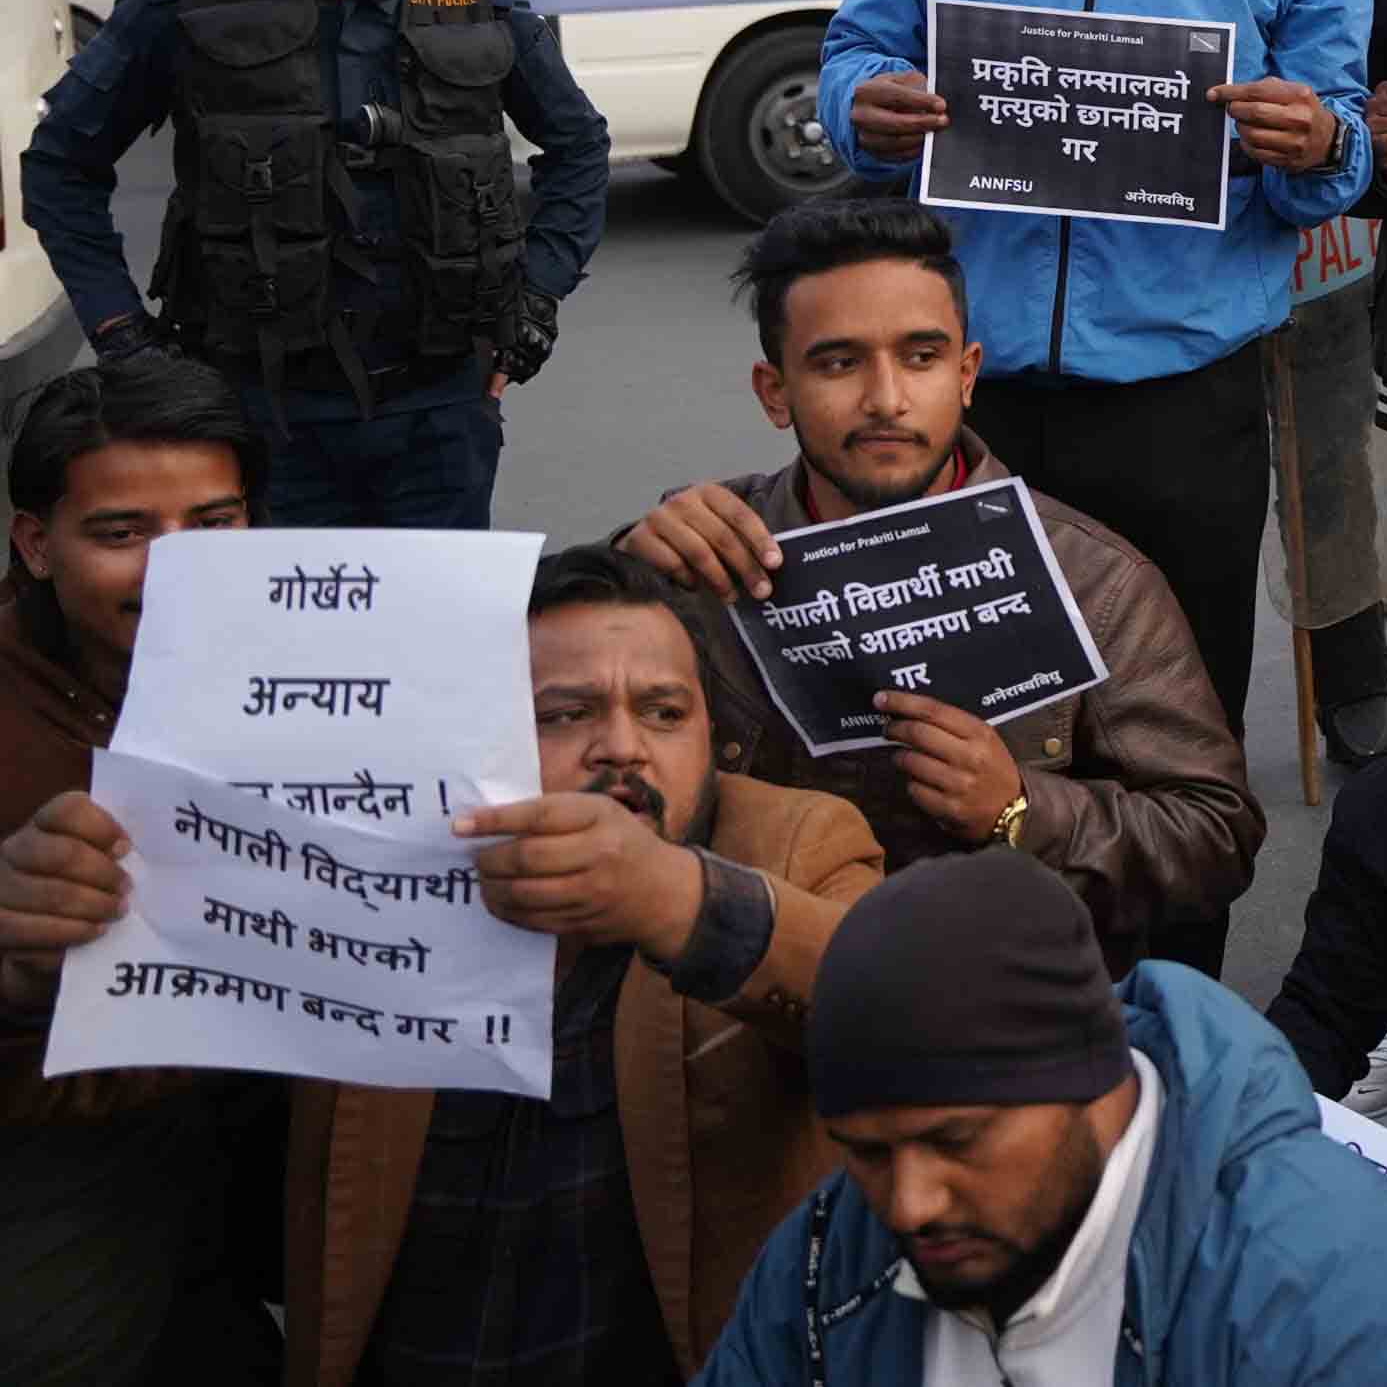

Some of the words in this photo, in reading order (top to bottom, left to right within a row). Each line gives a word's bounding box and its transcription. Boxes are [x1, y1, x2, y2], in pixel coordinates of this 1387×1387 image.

[1020, 25, 1055, 38] Justice
[1057, 28, 1071, 39] for
[1073, 30, 1109, 43] Prakriti
[1111, 34, 1144, 45] Lamsal
[971, 56, 1051, 91] प्रकृति
[1057, 66, 1190, 101] लम्सालको
[979, 94, 1070, 127] मृत्युको
[1077, 102, 1182, 135] छानबिन
[1062, 137, 1098, 163] गर
[969, 175, 1033, 193] ANNFSU
[802, 542, 839, 564] Justice
[840, 540, 857, 553] for
[858, 531, 895, 551] Prakriti
[895, 523, 932, 542] Lamsal
[268, 561, 380, 612] गोर्खेले
[762, 593, 841, 633] नेपाली
[844, 564, 943, 617] विद्यार्थी
[946, 547, 1015, 591] माथी
[781, 630, 851, 666] भएको
[858, 610, 972, 655] आक्रमण
[974, 592, 1032, 626] बन्द
[243, 675, 392, 718] अन्याय
[891, 662, 932, 691] गर
[203, 895, 299, 949] माथी
[308, 926, 433, 974] भएको
[106, 961, 291, 1013] आक्रमण
[300, 990, 385, 1037] बन्द
[396, 1014, 458, 1045] गर
[485, 1014, 512, 1046] !!
